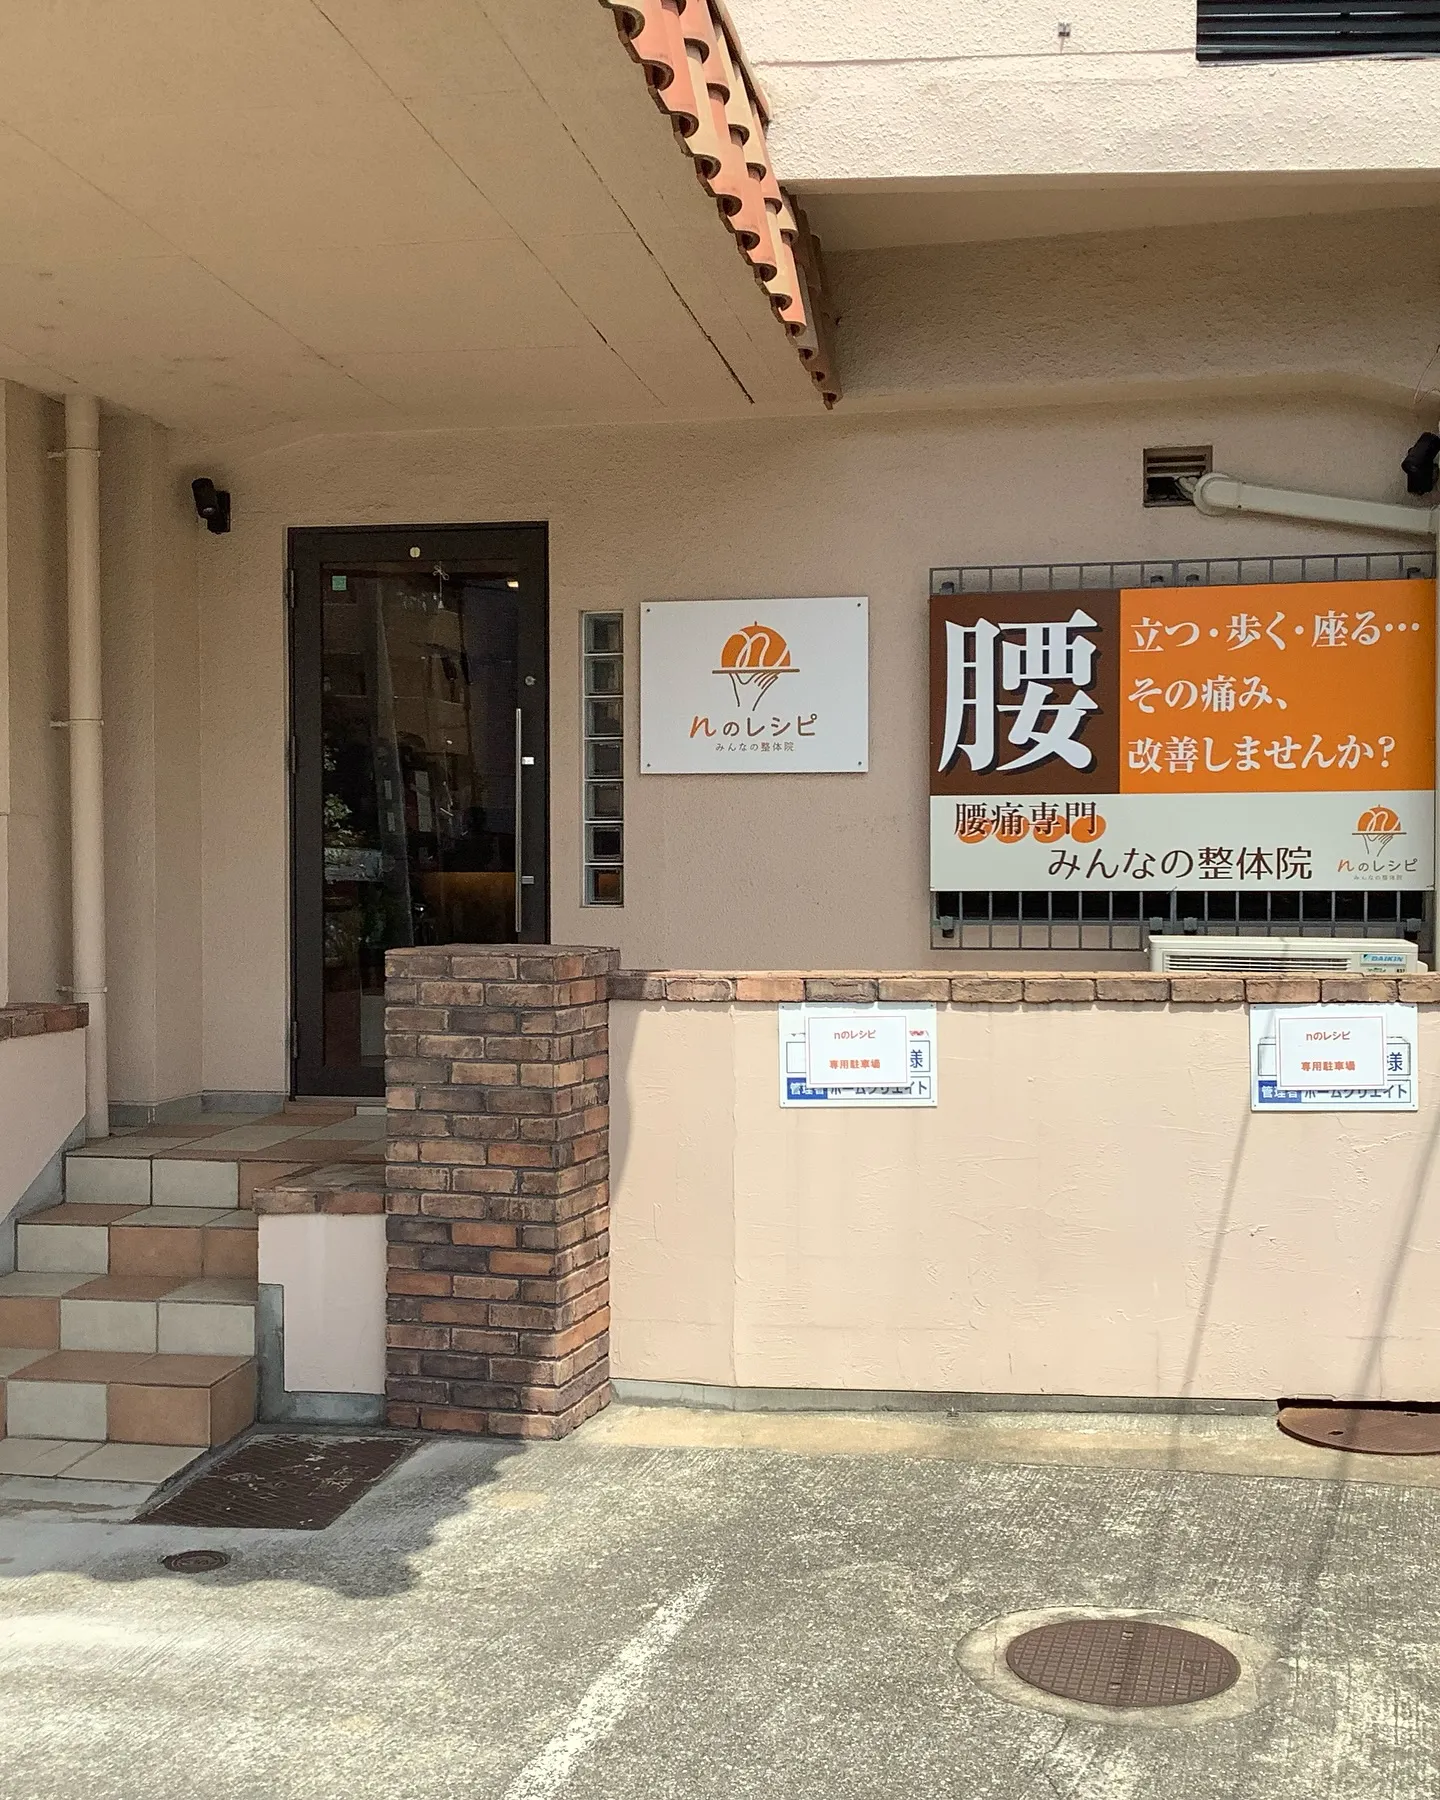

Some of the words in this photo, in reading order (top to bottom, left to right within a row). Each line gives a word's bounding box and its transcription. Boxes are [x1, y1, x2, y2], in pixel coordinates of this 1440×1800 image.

[937, 609, 1098, 773] 腰
[1128, 674, 1287, 713] その痛み、
[690, 713, 817, 738] nのレシピ
[715, 742, 795, 751] みんなの整体院
[954, 801, 1097, 836] 腰痛専門
[1048, 846, 1312, 880] みんなの整体院
[1337, 858, 1418, 872] nのレシピ
[829, 1059, 880, 1069] 専用駐車場
[1301, 1061, 1356, 1071] 専用駐車場
